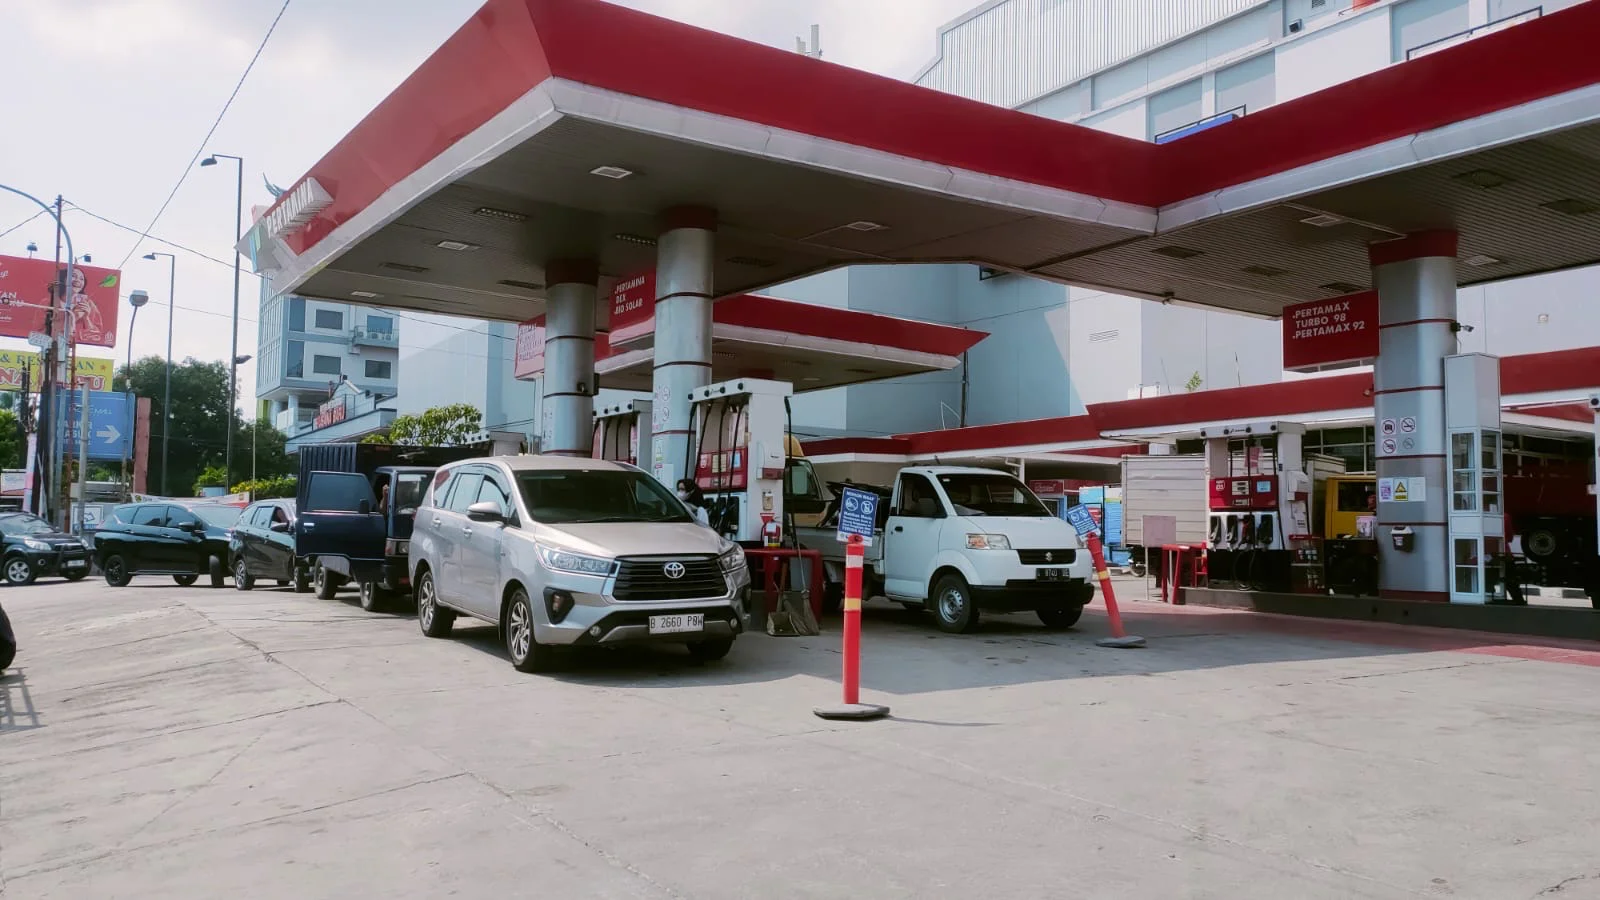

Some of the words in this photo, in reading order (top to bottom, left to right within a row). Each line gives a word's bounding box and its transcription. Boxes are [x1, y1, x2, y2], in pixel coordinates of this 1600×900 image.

[625, 298, 643, 312] SOLAR
[1296, 316, 1329, 328] TURBO
[1333, 313, 1346, 323] 98
[1353, 321, 1365, 330] 92
[651, 618, 656, 629] B
[661, 617, 681, 628] 2660
